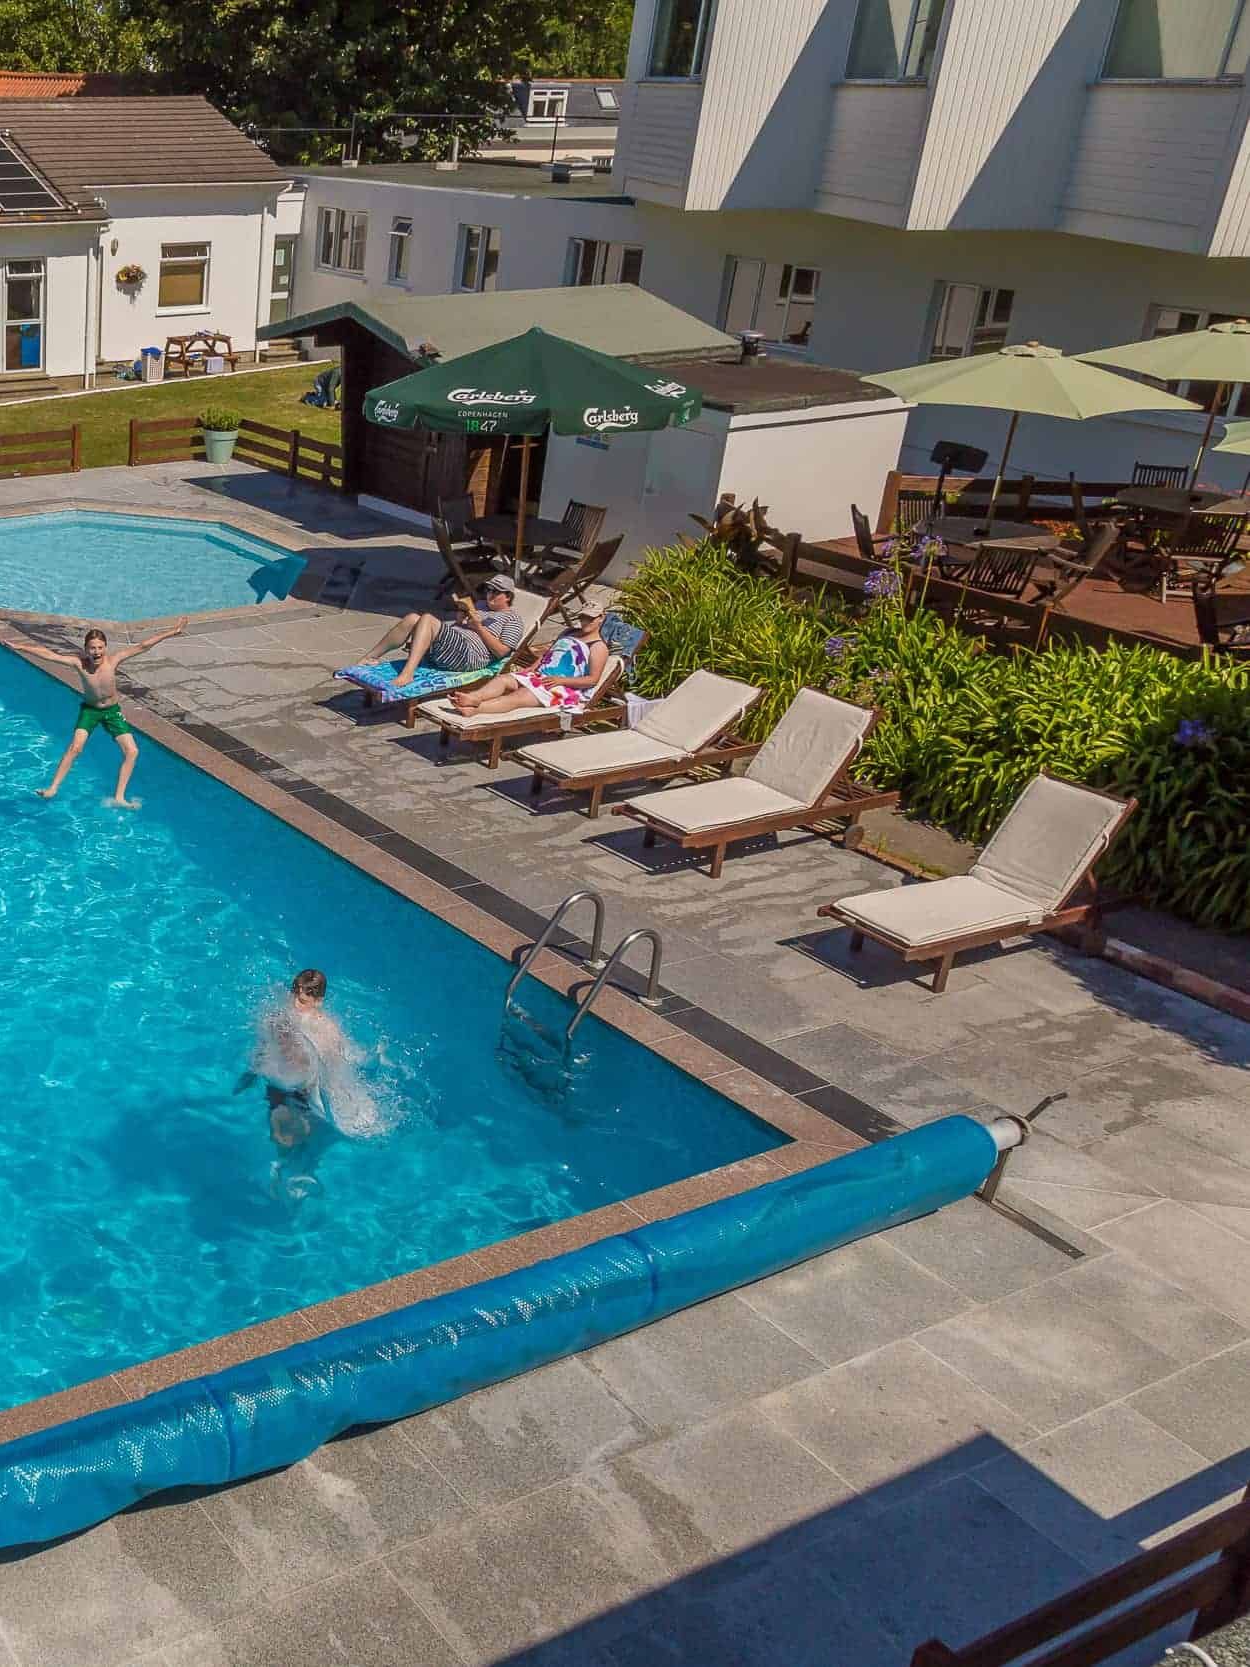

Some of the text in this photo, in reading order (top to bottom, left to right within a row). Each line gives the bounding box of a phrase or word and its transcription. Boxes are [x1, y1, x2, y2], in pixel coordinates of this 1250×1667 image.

[447, 388, 536, 406] Carlsberg
[457, 410, 509, 418] COPENHAGEN
[583, 405, 639, 431] Carlsberg
[466, 419, 497, 432] 1847
